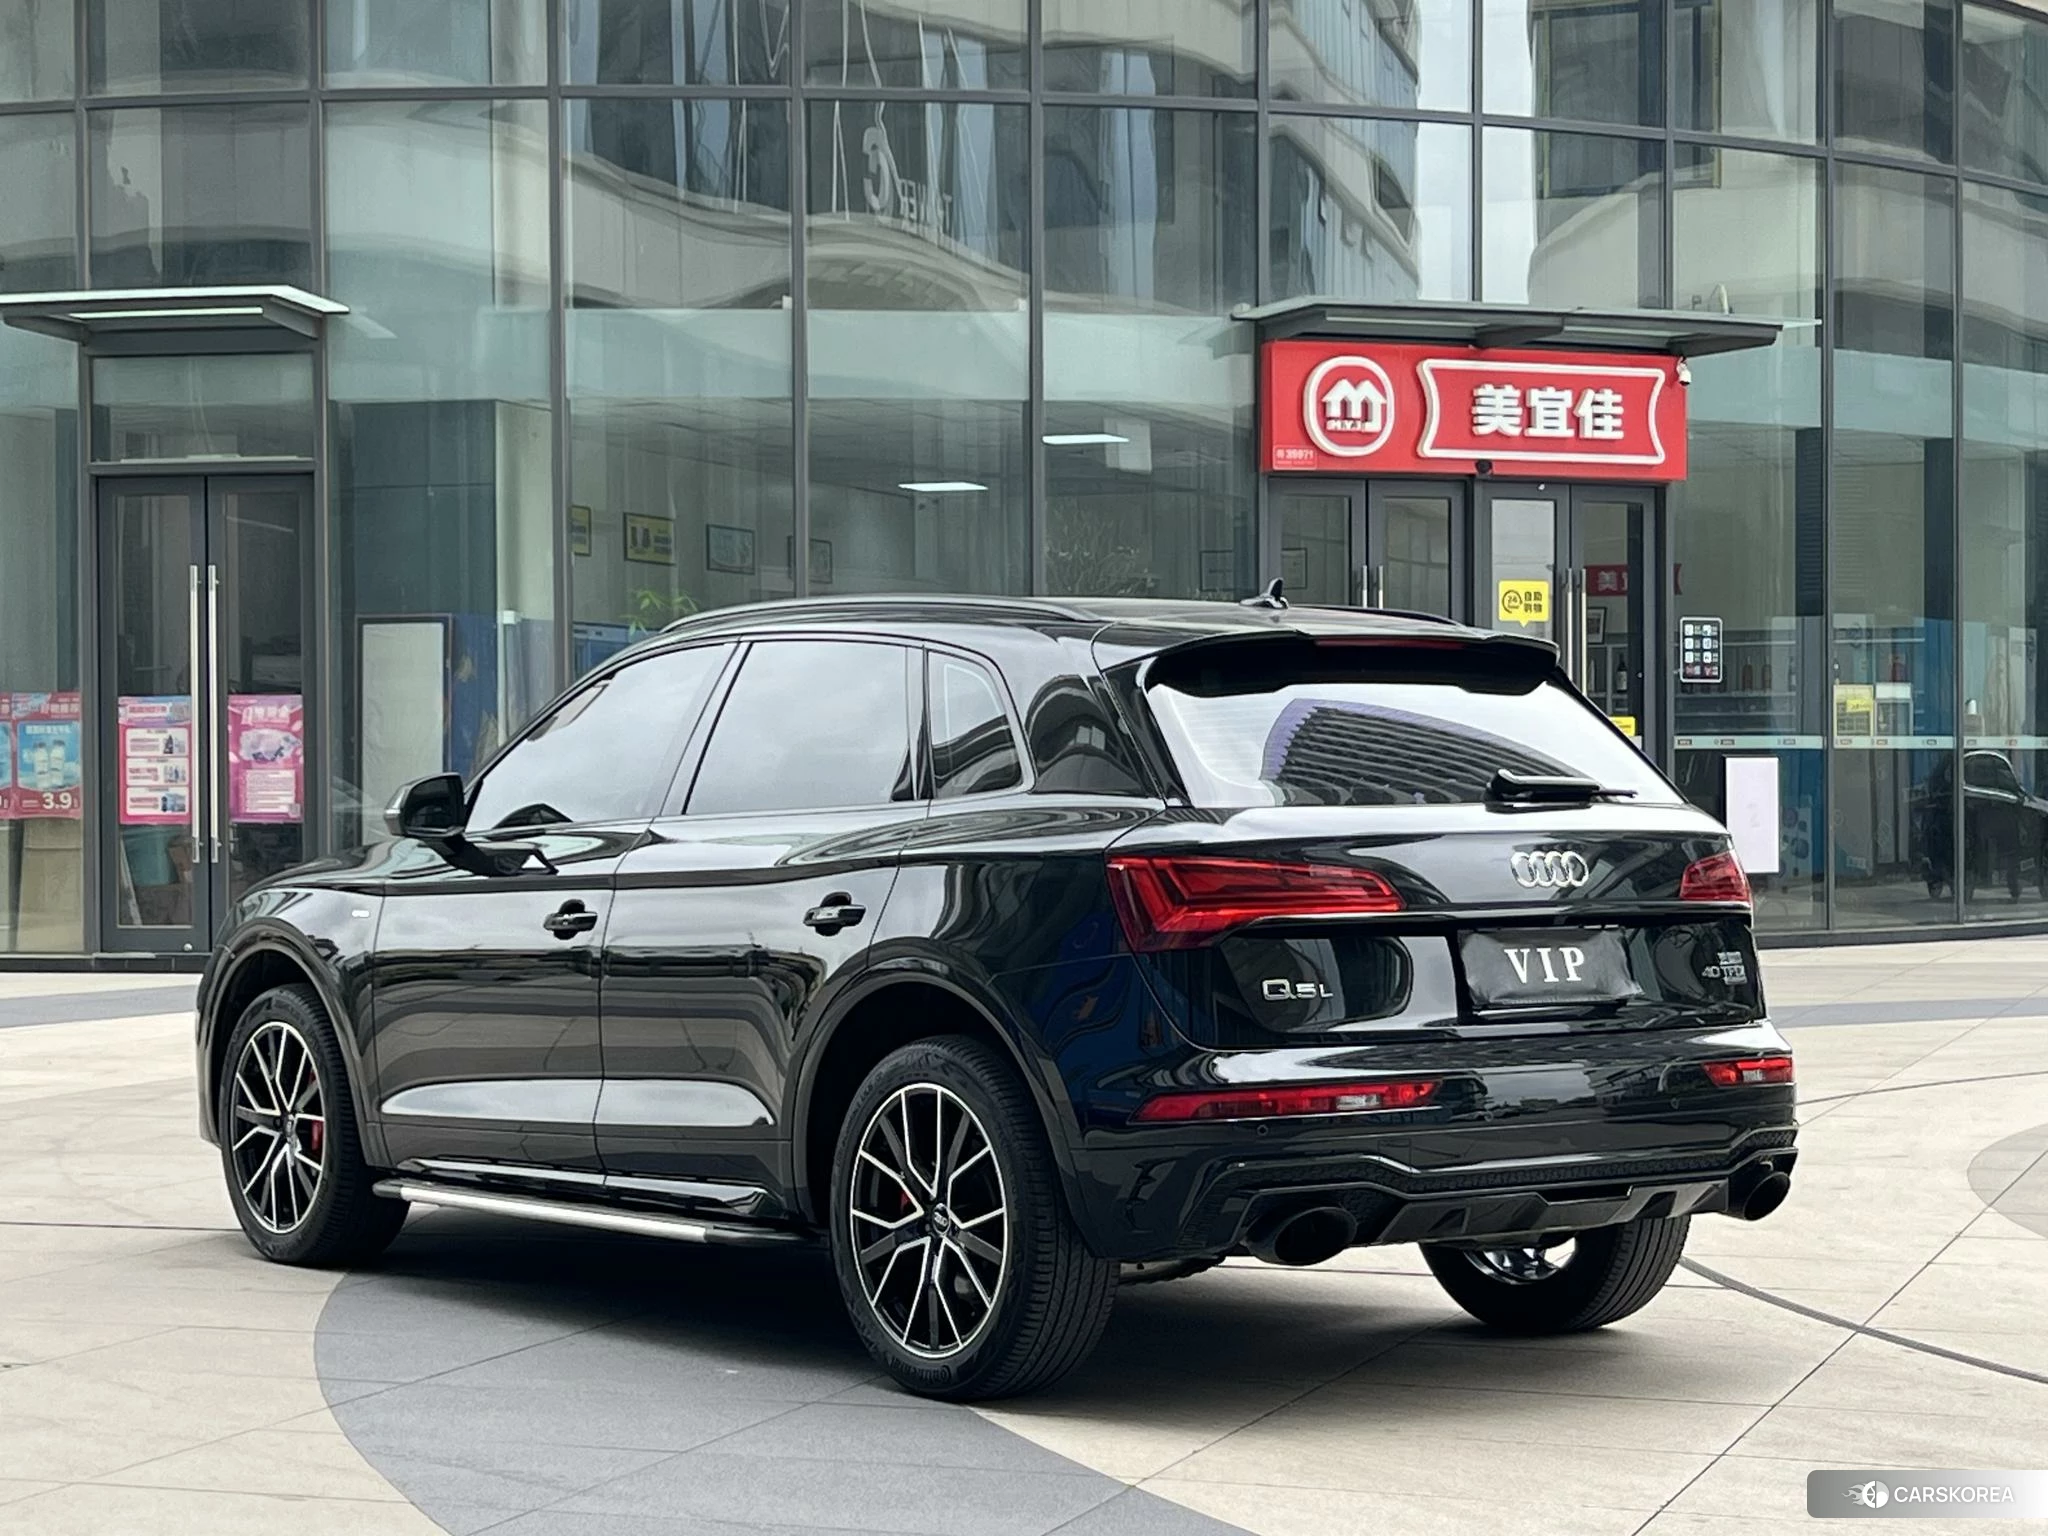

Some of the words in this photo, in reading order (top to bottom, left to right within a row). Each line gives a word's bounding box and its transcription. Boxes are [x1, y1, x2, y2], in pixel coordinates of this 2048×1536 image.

[1471, 384, 1624, 440] 美宜佳
[42, 792, 72, 809] 3.9
[1503, 947, 1585, 984] VIP
[1262, 979, 1334, 1000] Q5L
